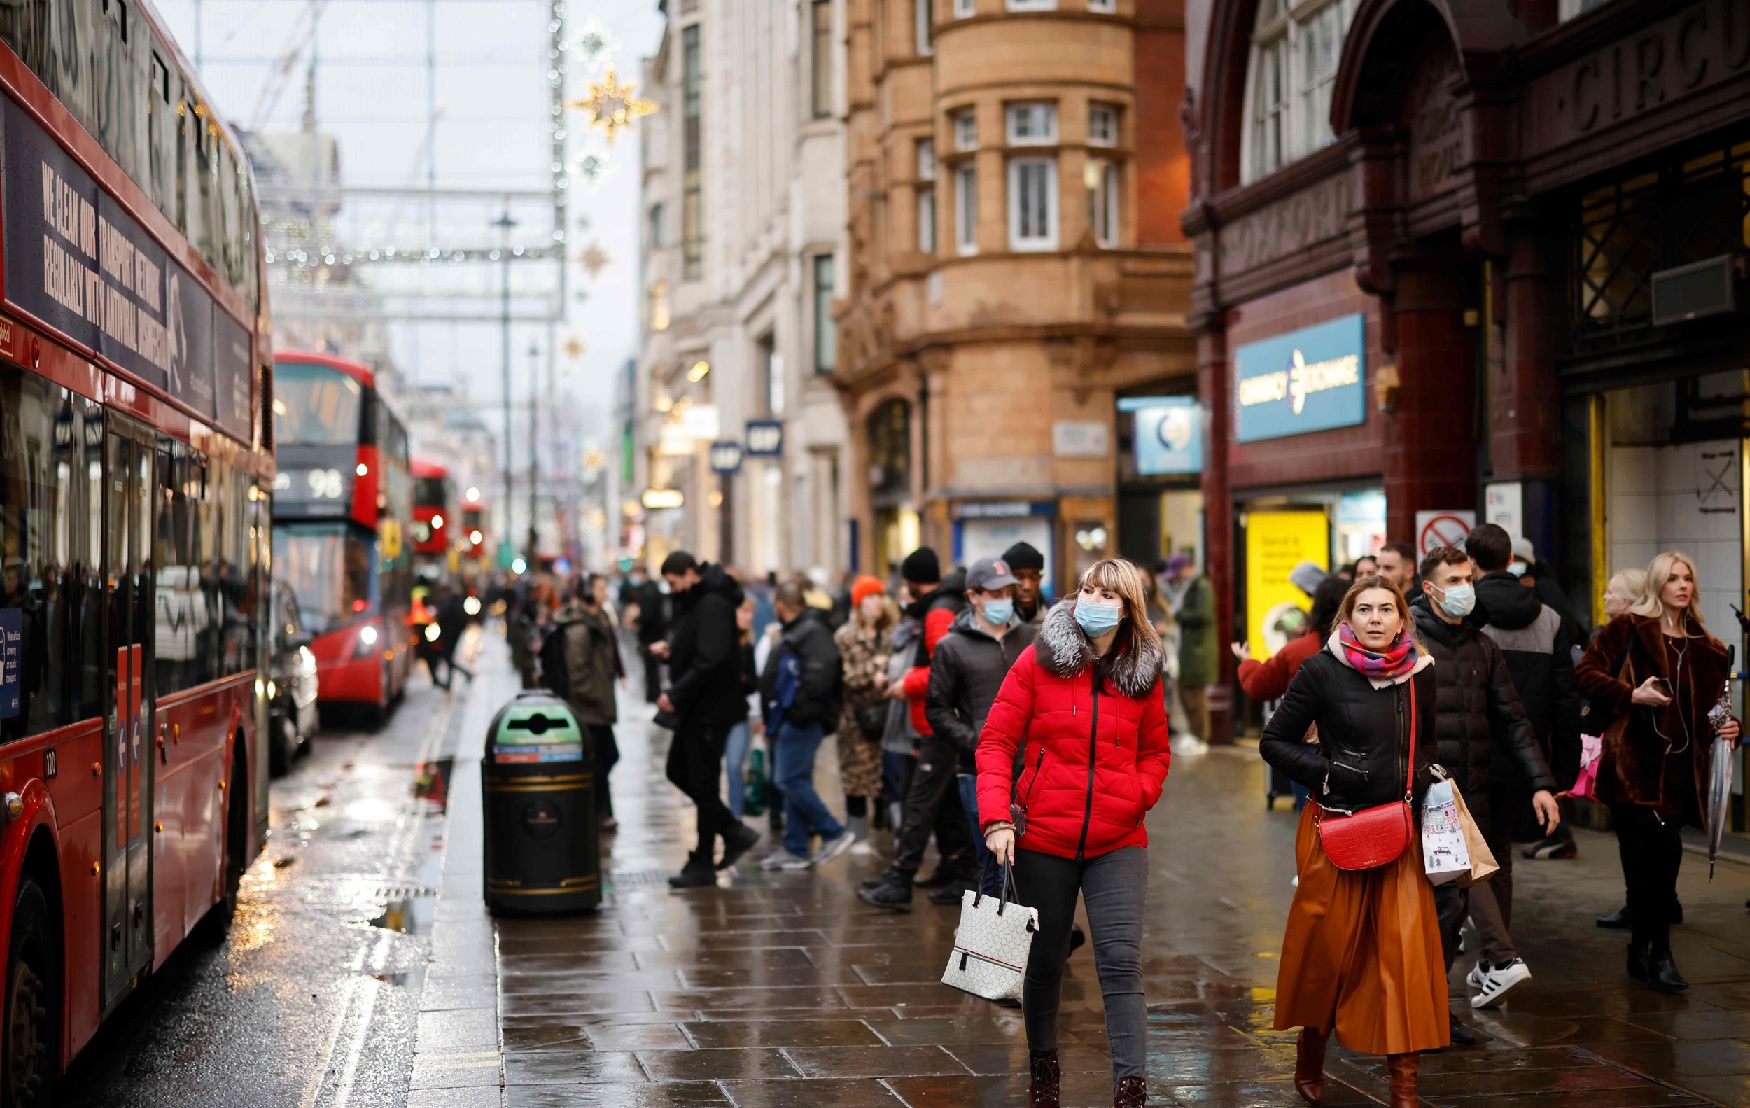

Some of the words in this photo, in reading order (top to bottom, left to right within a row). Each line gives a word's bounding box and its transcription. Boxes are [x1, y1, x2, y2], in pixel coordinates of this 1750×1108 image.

[42, 160, 55, 228] WE
[56, 174, 79, 248] CLEAN
[80, 197, 97, 261] OUR
[98, 214, 135, 292] TRANSPORT
[43, 233, 84, 318] REGULARLY
[85, 266, 105, 333] WITH
[308, 468, 343, 499] 98
